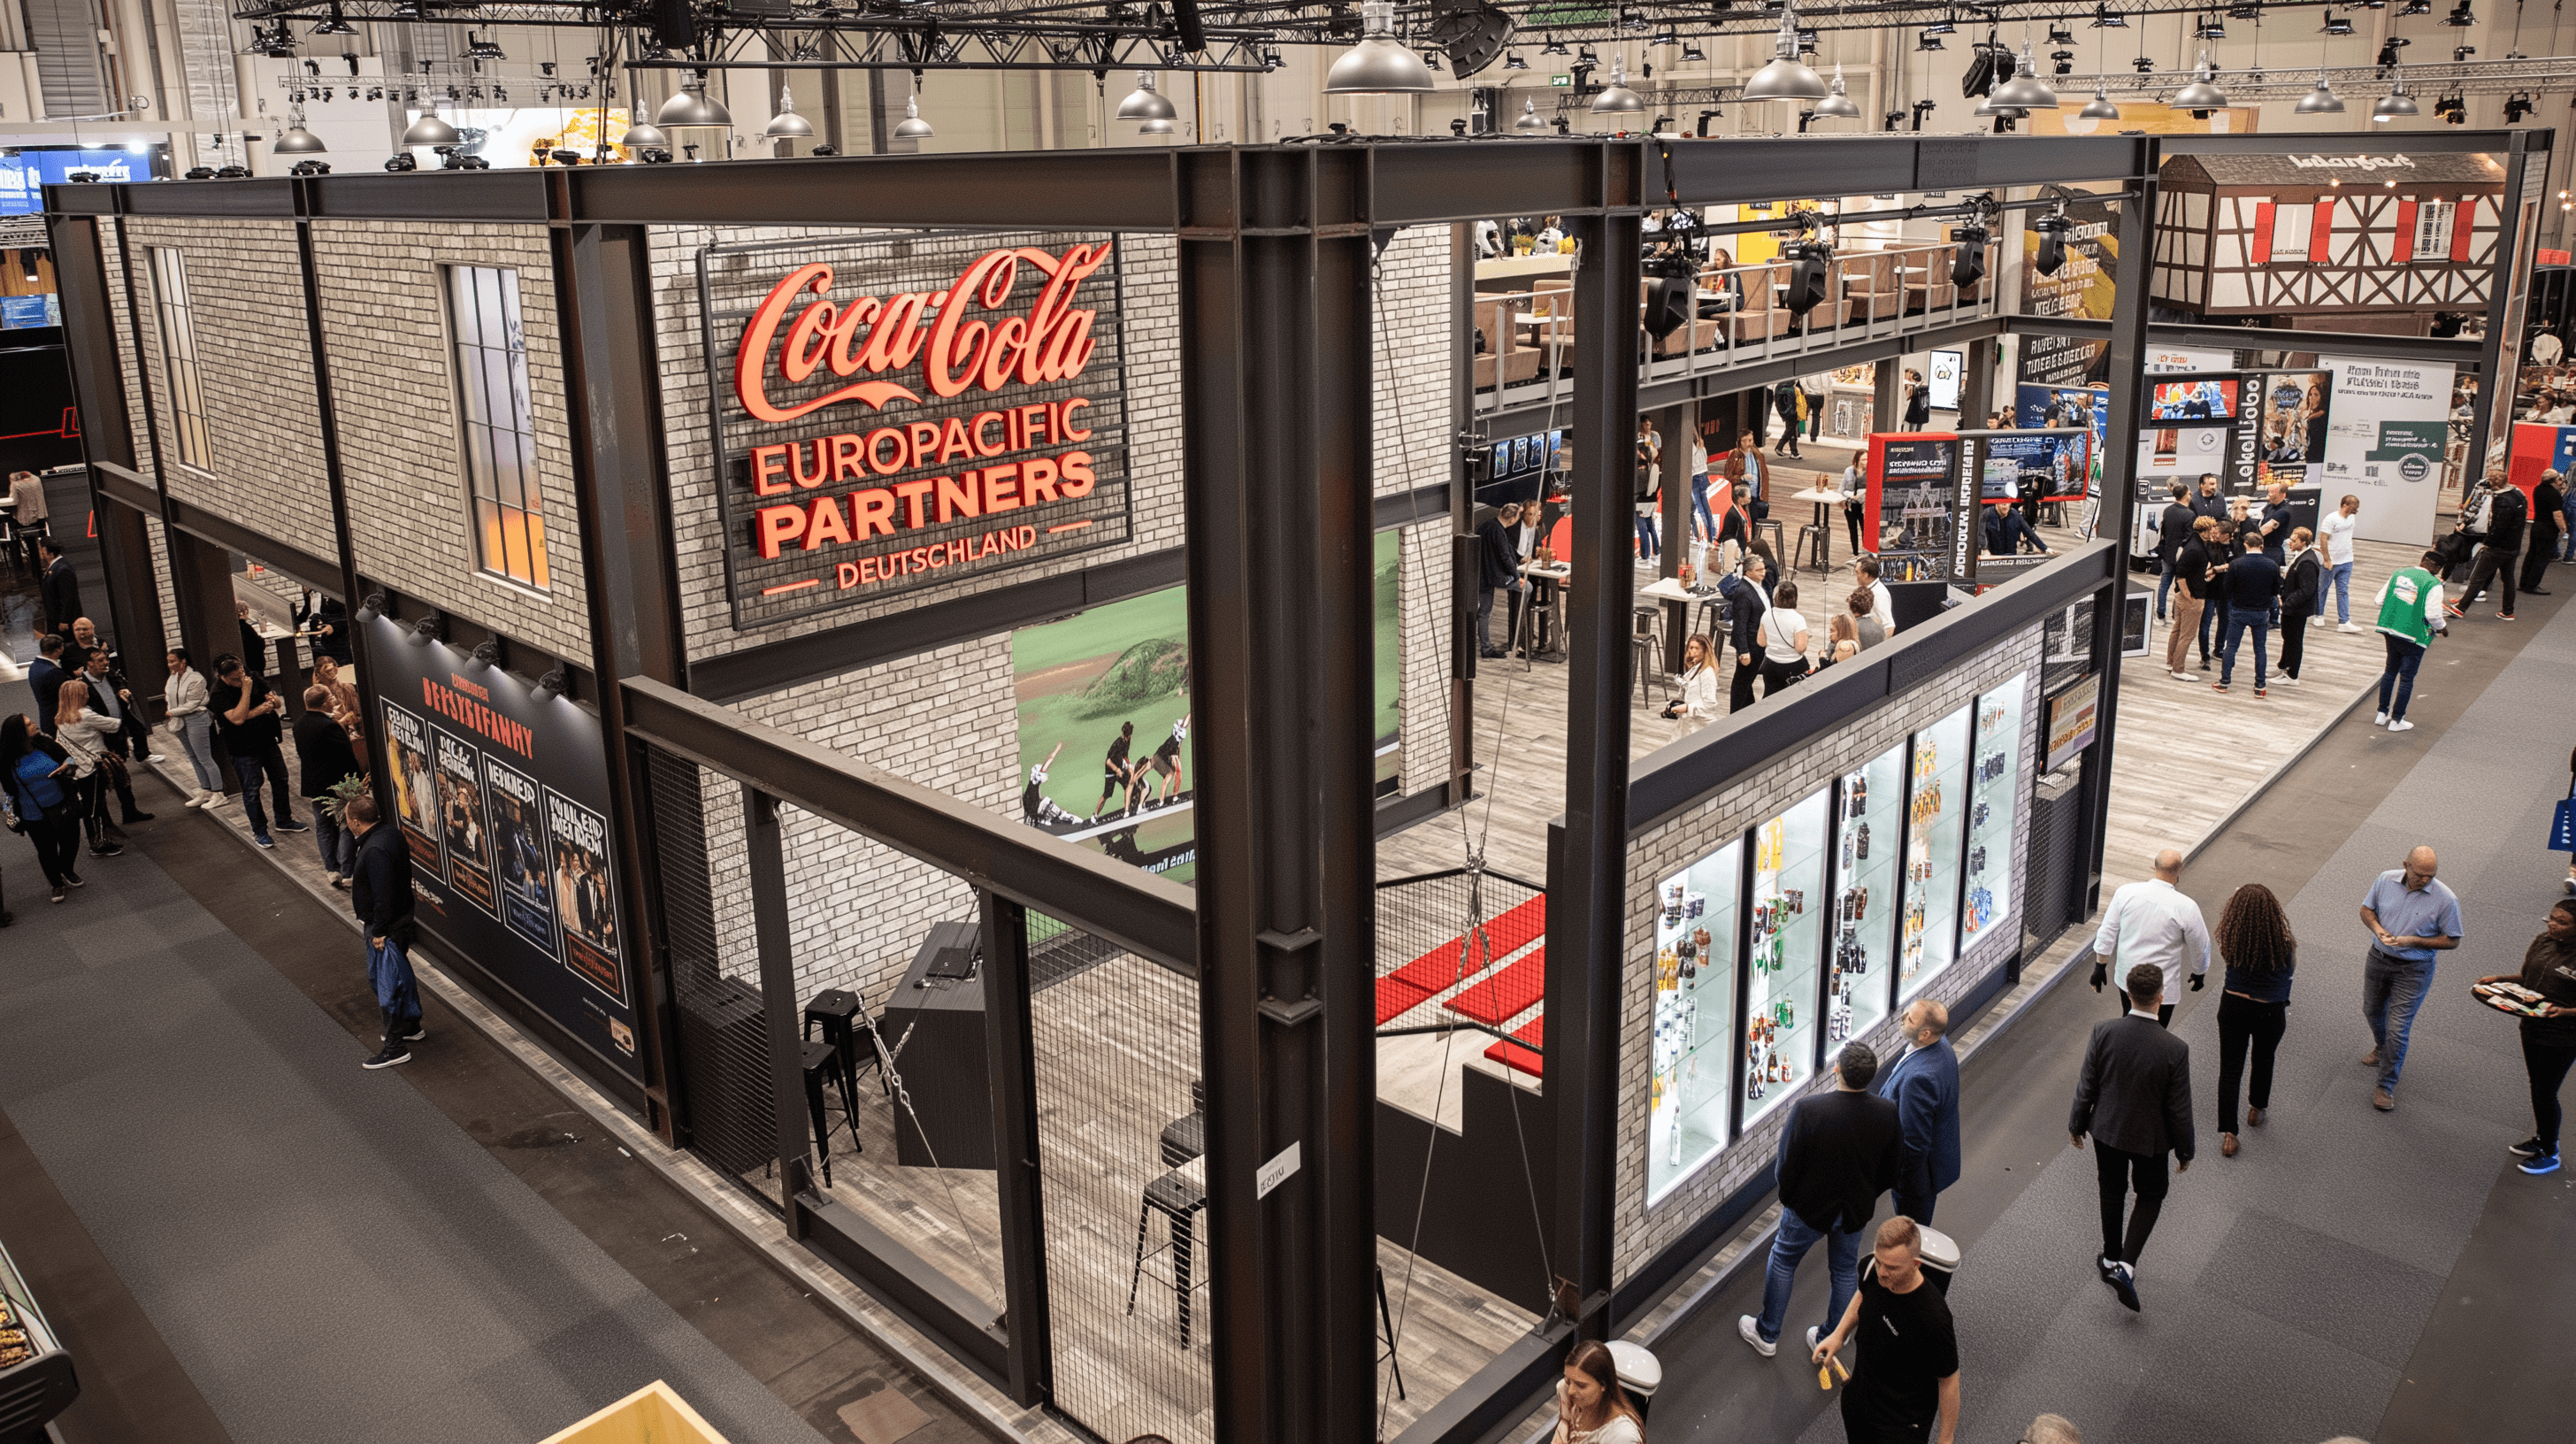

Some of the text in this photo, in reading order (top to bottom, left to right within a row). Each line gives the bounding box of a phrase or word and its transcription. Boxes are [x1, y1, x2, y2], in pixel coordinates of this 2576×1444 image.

[734, 240, 1113, 423] Coca-Cola
[750, 397, 1093, 496] EUROPACIFIC
[755, 451, 1096, 559] PARTNERS
[835, 526, 1037, 590] DEUTSCHLAND
